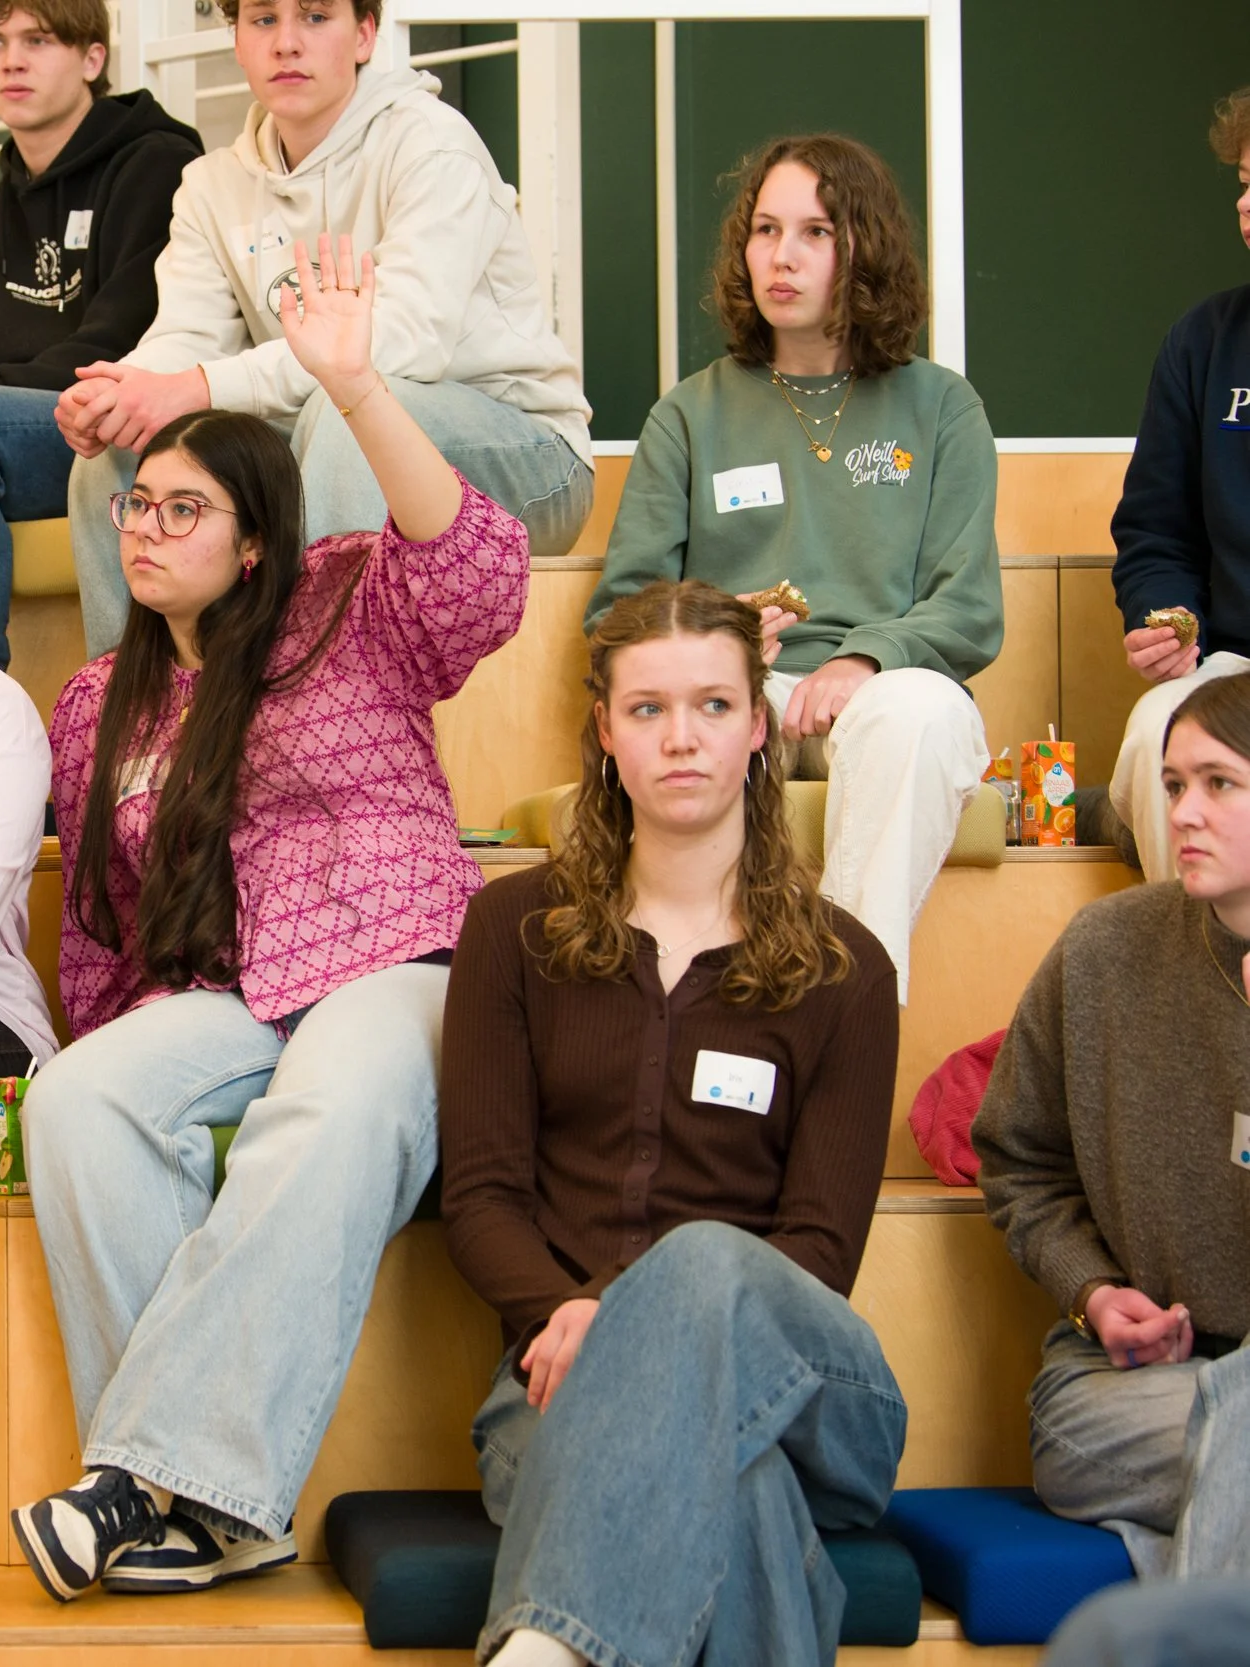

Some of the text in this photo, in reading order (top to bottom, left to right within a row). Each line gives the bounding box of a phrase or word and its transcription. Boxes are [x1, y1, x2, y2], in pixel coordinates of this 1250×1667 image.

[844, 439, 898, 472] O'Neill
[852, 461, 911, 488] Surf Shop
